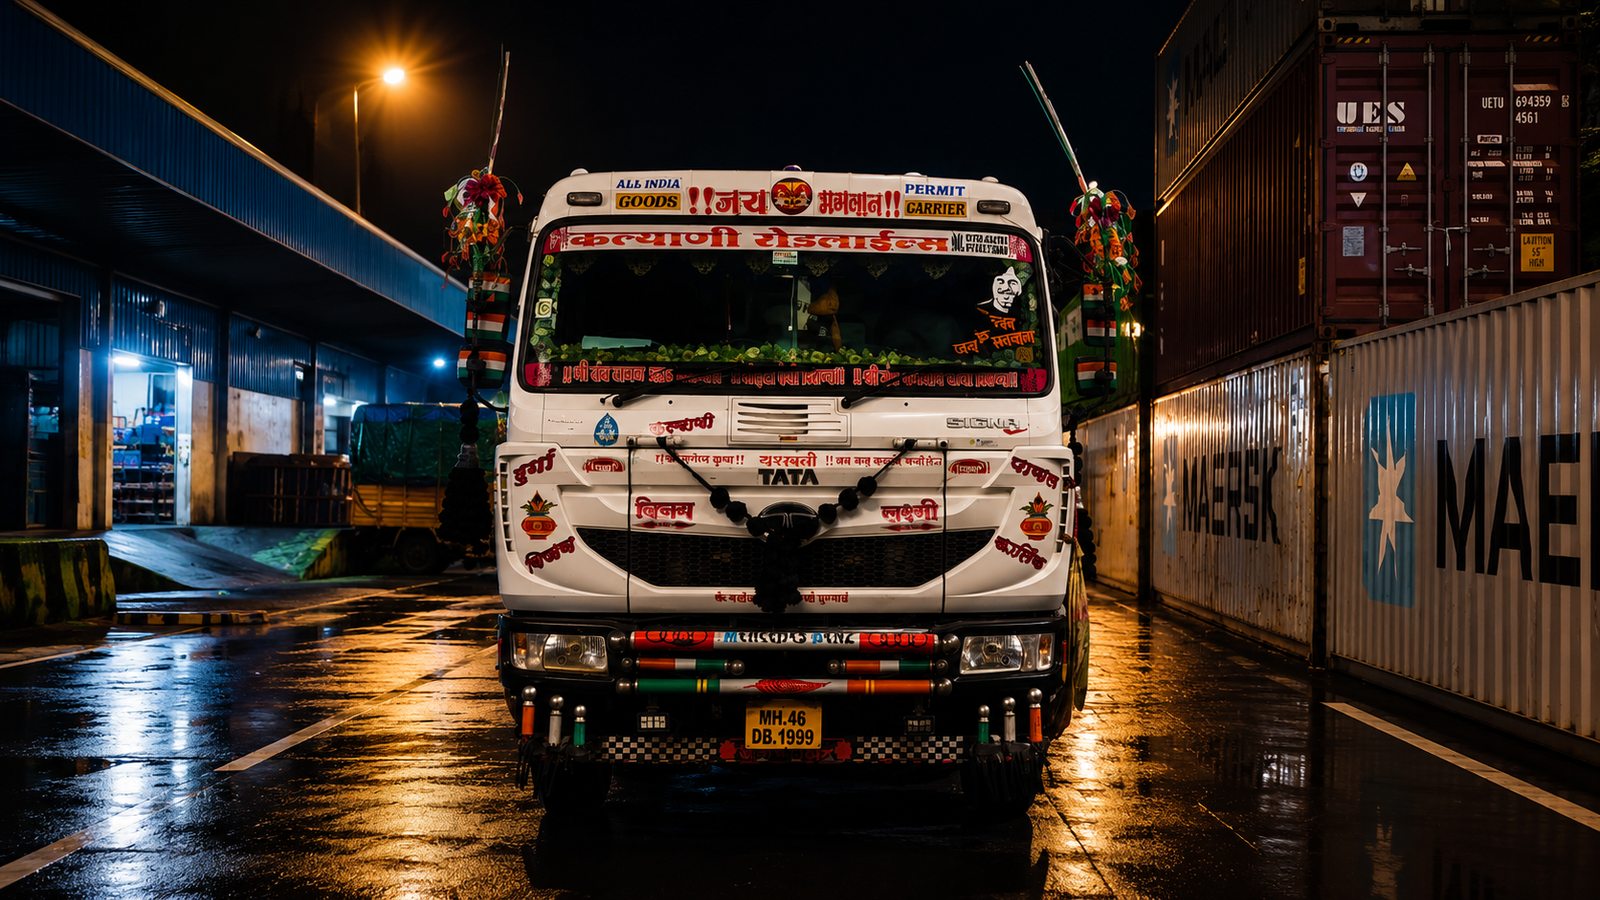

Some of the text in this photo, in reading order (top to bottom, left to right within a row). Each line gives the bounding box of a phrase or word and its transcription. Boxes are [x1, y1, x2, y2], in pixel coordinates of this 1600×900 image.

[1481, 96, 1504, 109] UETU
[1515, 95, 1551, 108] 694359
[1336, 101, 1405, 124] UES
[1515, 111, 1539, 124] 4561
[644, 178, 681, 190] INDIA
[904, 183, 966, 197] PERMIT
[618, 194, 678, 209] GOODS
[906, 202, 966, 216] CARRIER
[946, 417, 1021, 430] SIGNA
[758, 469, 819, 485] TATA
[1182, 446, 1282, 545] MAERSK
[1436, 431, 1600, 591] MAE
[759, 709, 806, 726] MH.46
[752, 728, 814, 745] DB.1999
